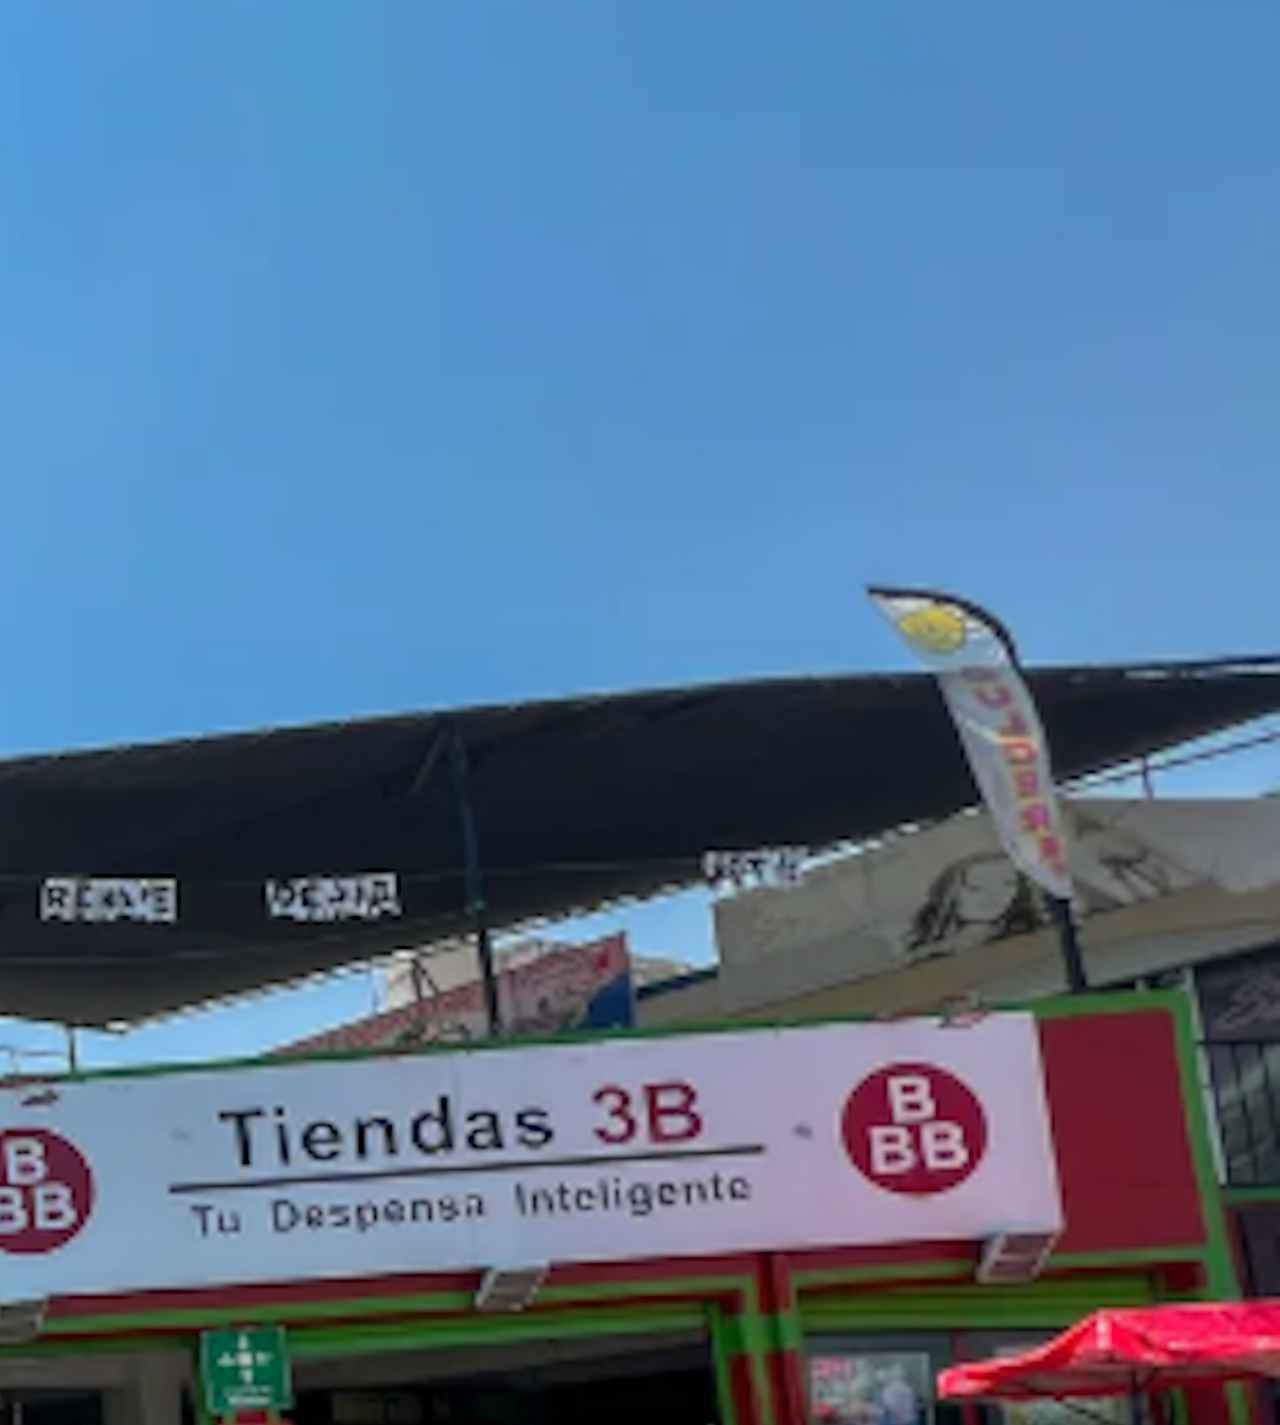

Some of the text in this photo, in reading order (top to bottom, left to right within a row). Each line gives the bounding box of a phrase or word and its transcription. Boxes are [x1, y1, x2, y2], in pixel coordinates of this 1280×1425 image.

[218, 1081, 704, 1168] Tiendas 3B
[191, 1172, 751, 1238] Tu Despensa Inteligente
